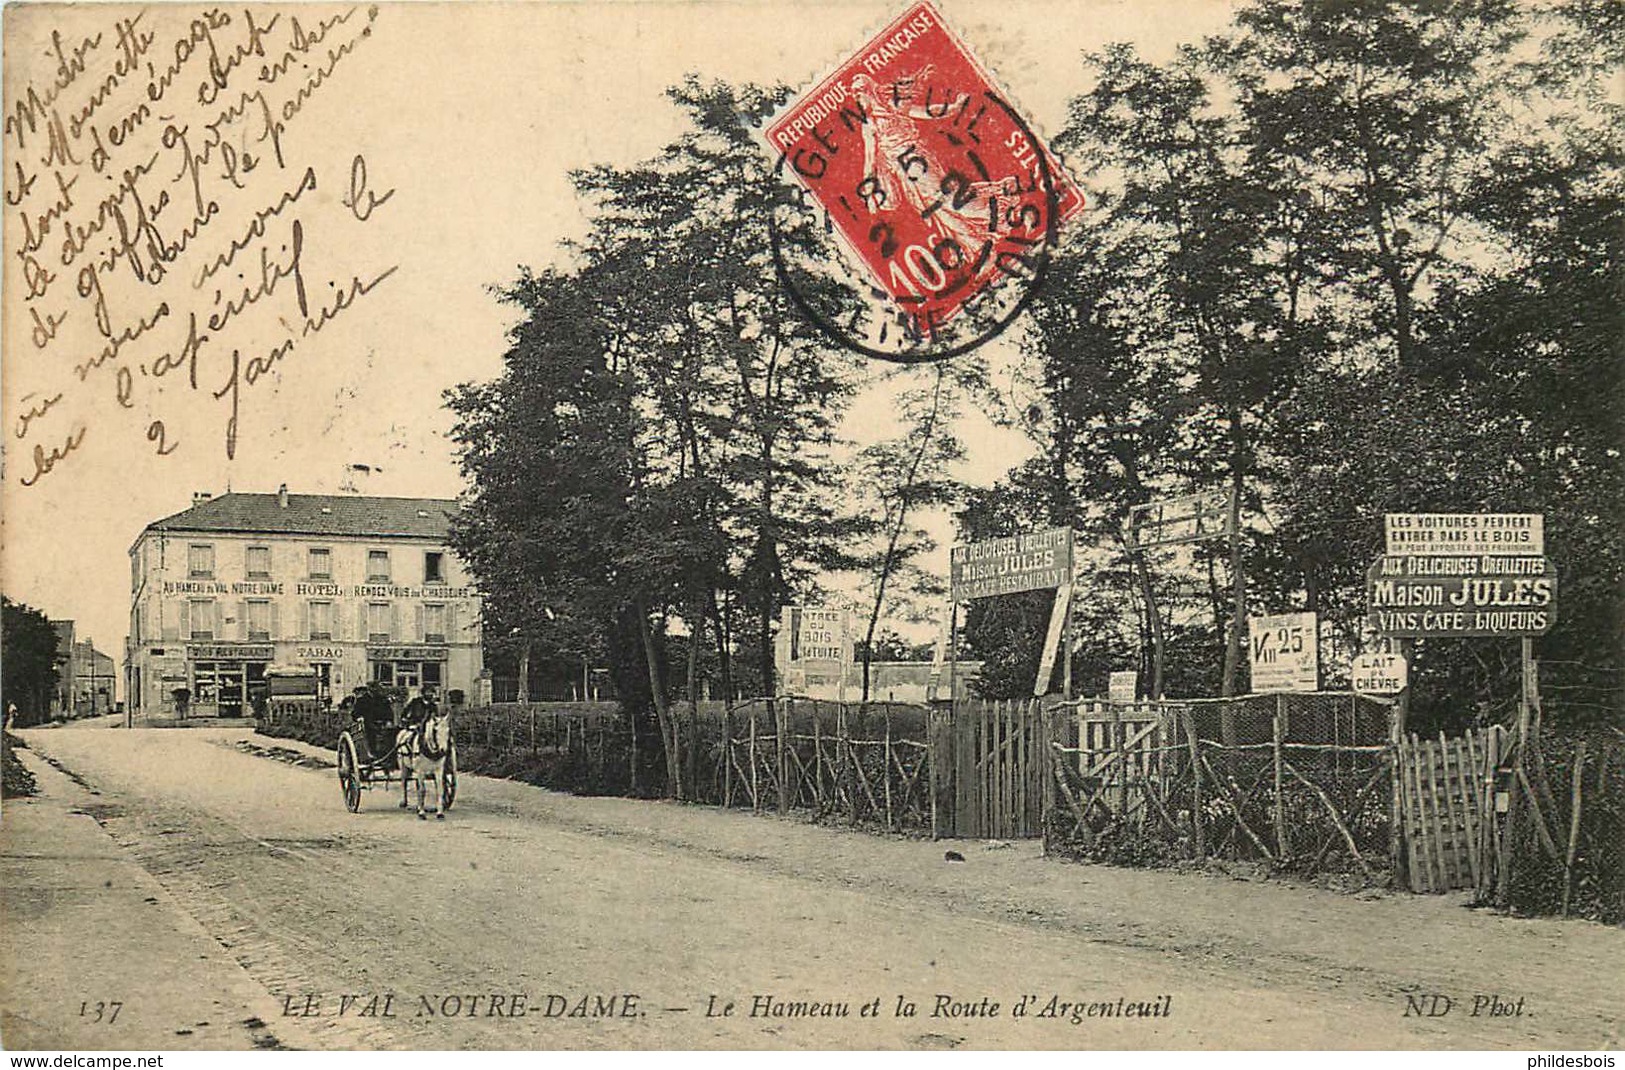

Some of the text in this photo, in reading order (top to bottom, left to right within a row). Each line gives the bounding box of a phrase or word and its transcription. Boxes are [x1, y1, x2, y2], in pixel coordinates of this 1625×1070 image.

[775, 11, 934, 147] REPUBLIQUE FRANÇAISE
[343, 154, 396, 221] le
[147, 421, 179, 456] 2
[1390, 516, 1532, 528] LES VOITURES PEUVENT
[1440, 531, 1468, 542] DANS
[1474, 531, 1489, 542] LE
[1493, 531, 1530, 543] BOIS
[998, 549, 1055, 575] JULES
[1380, 558, 1402, 575] AUX
[1482, 555, 1546, 575] OREILLETTES
[214, 582, 229, 594] VAL
[232, 583, 259, 594] NOTRE
[260, 583, 284, 595] DAME
[297, 584, 343, 597] HOTEL
[355, 586, 387, 597] RENDEZ
[388, 586, 410, 597] VOUS
[1000, 567, 1068, 593] RESTAURANT
[1371, 578, 1551, 607] Maison JULES
[1475, 610, 1548, 633] LIQUEURS
[804, 631, 832, 643] BOIS
[1278, 626, 1303, 654] 25
[297, 648, 343, 658] TABAC
[1362, 656, 1396, 669] LAIT
[1356, 678, 1400, 690] CHEVRE
